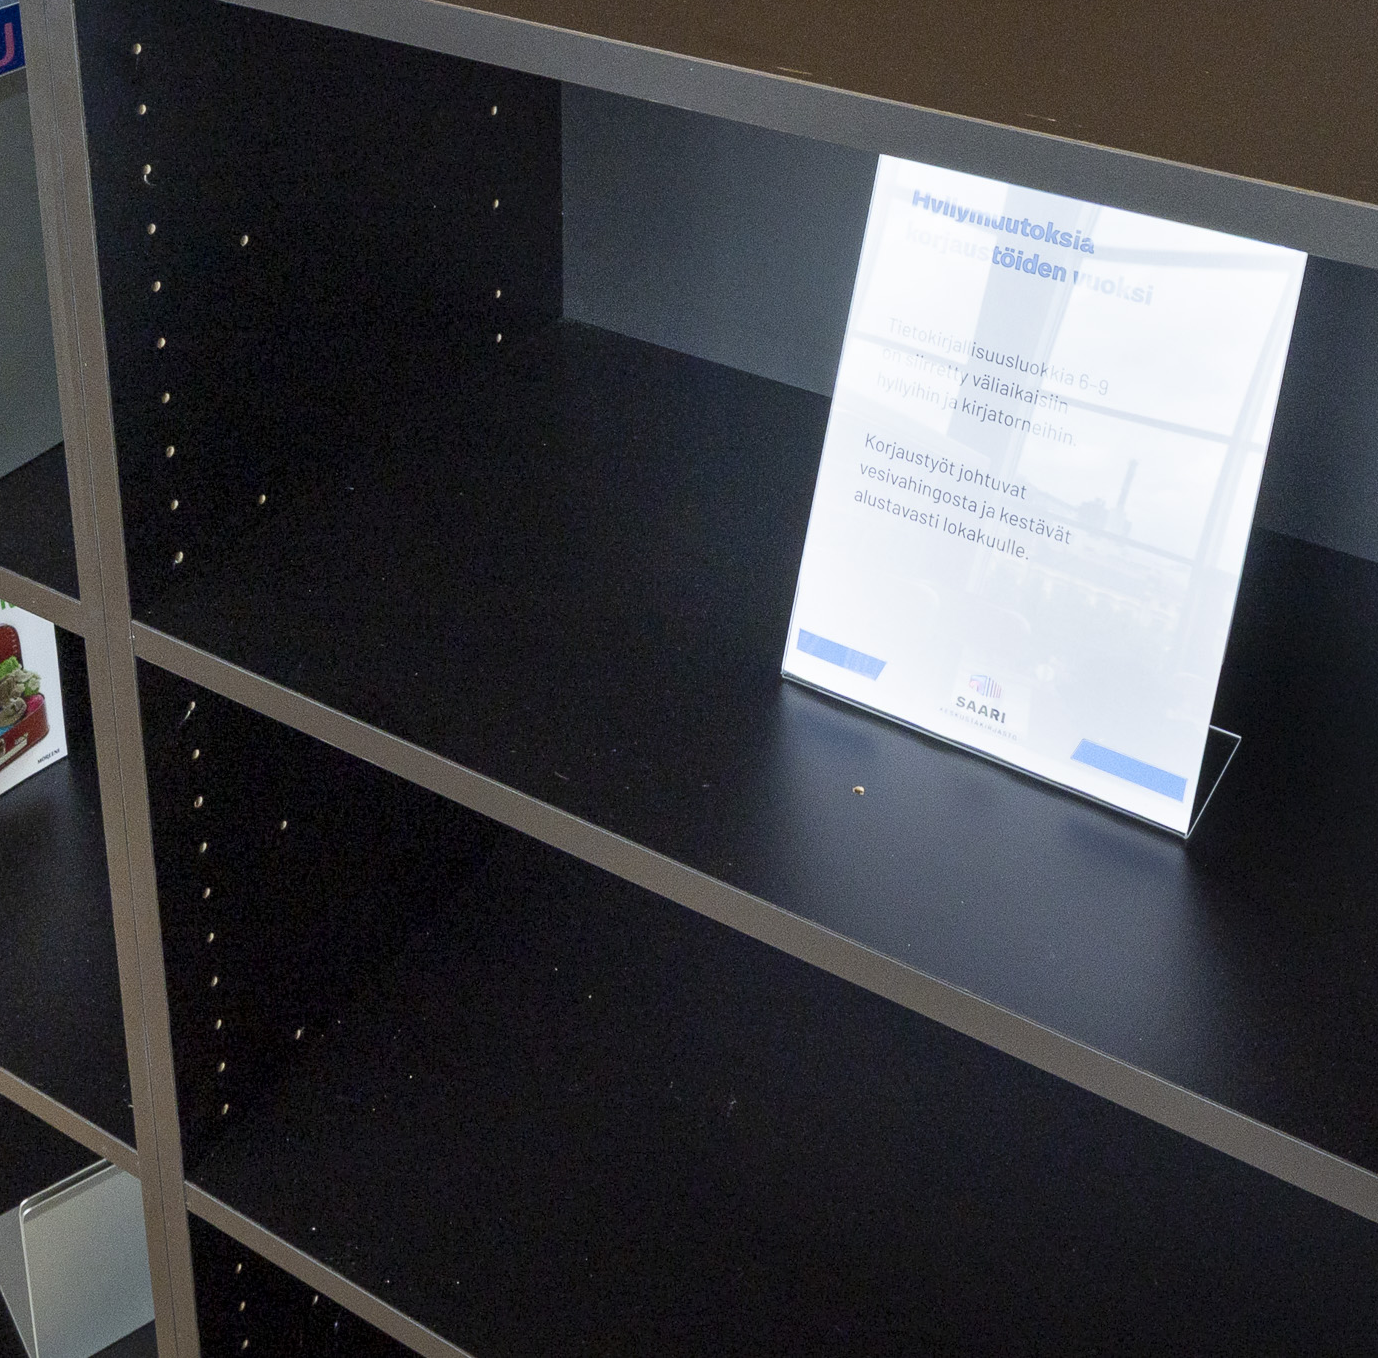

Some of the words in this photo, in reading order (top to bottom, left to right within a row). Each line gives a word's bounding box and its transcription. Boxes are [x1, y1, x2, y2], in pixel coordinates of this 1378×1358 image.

[1072, 269, 1155, 306] vuoksi
[888, 317, 1075, 387] Tietokirjallisuusluokkia
[906, 353, 969, 386] siirretty
[972, 373, 1069, 414] väliaikaisiin
[876, 372, 940, 406] hyllyihin
[942, 392, 958, 411] ja
[961, 397, 1077, 447] kirjatorneihin.
[864, 433, 956, 477] Korjaustyöt
[956, 464, 1028, 500] johtuvat
[854, 490, 941, 530] alustavasti
[943, 517, 1030, 561] lokakuulle.
[860, 463, 978, 513] vesivahingosta
[979, 501, 996, 520] ja
[999, 507, 1072, 545] kestävät
[955, 695, 1006, 724] SAARI
